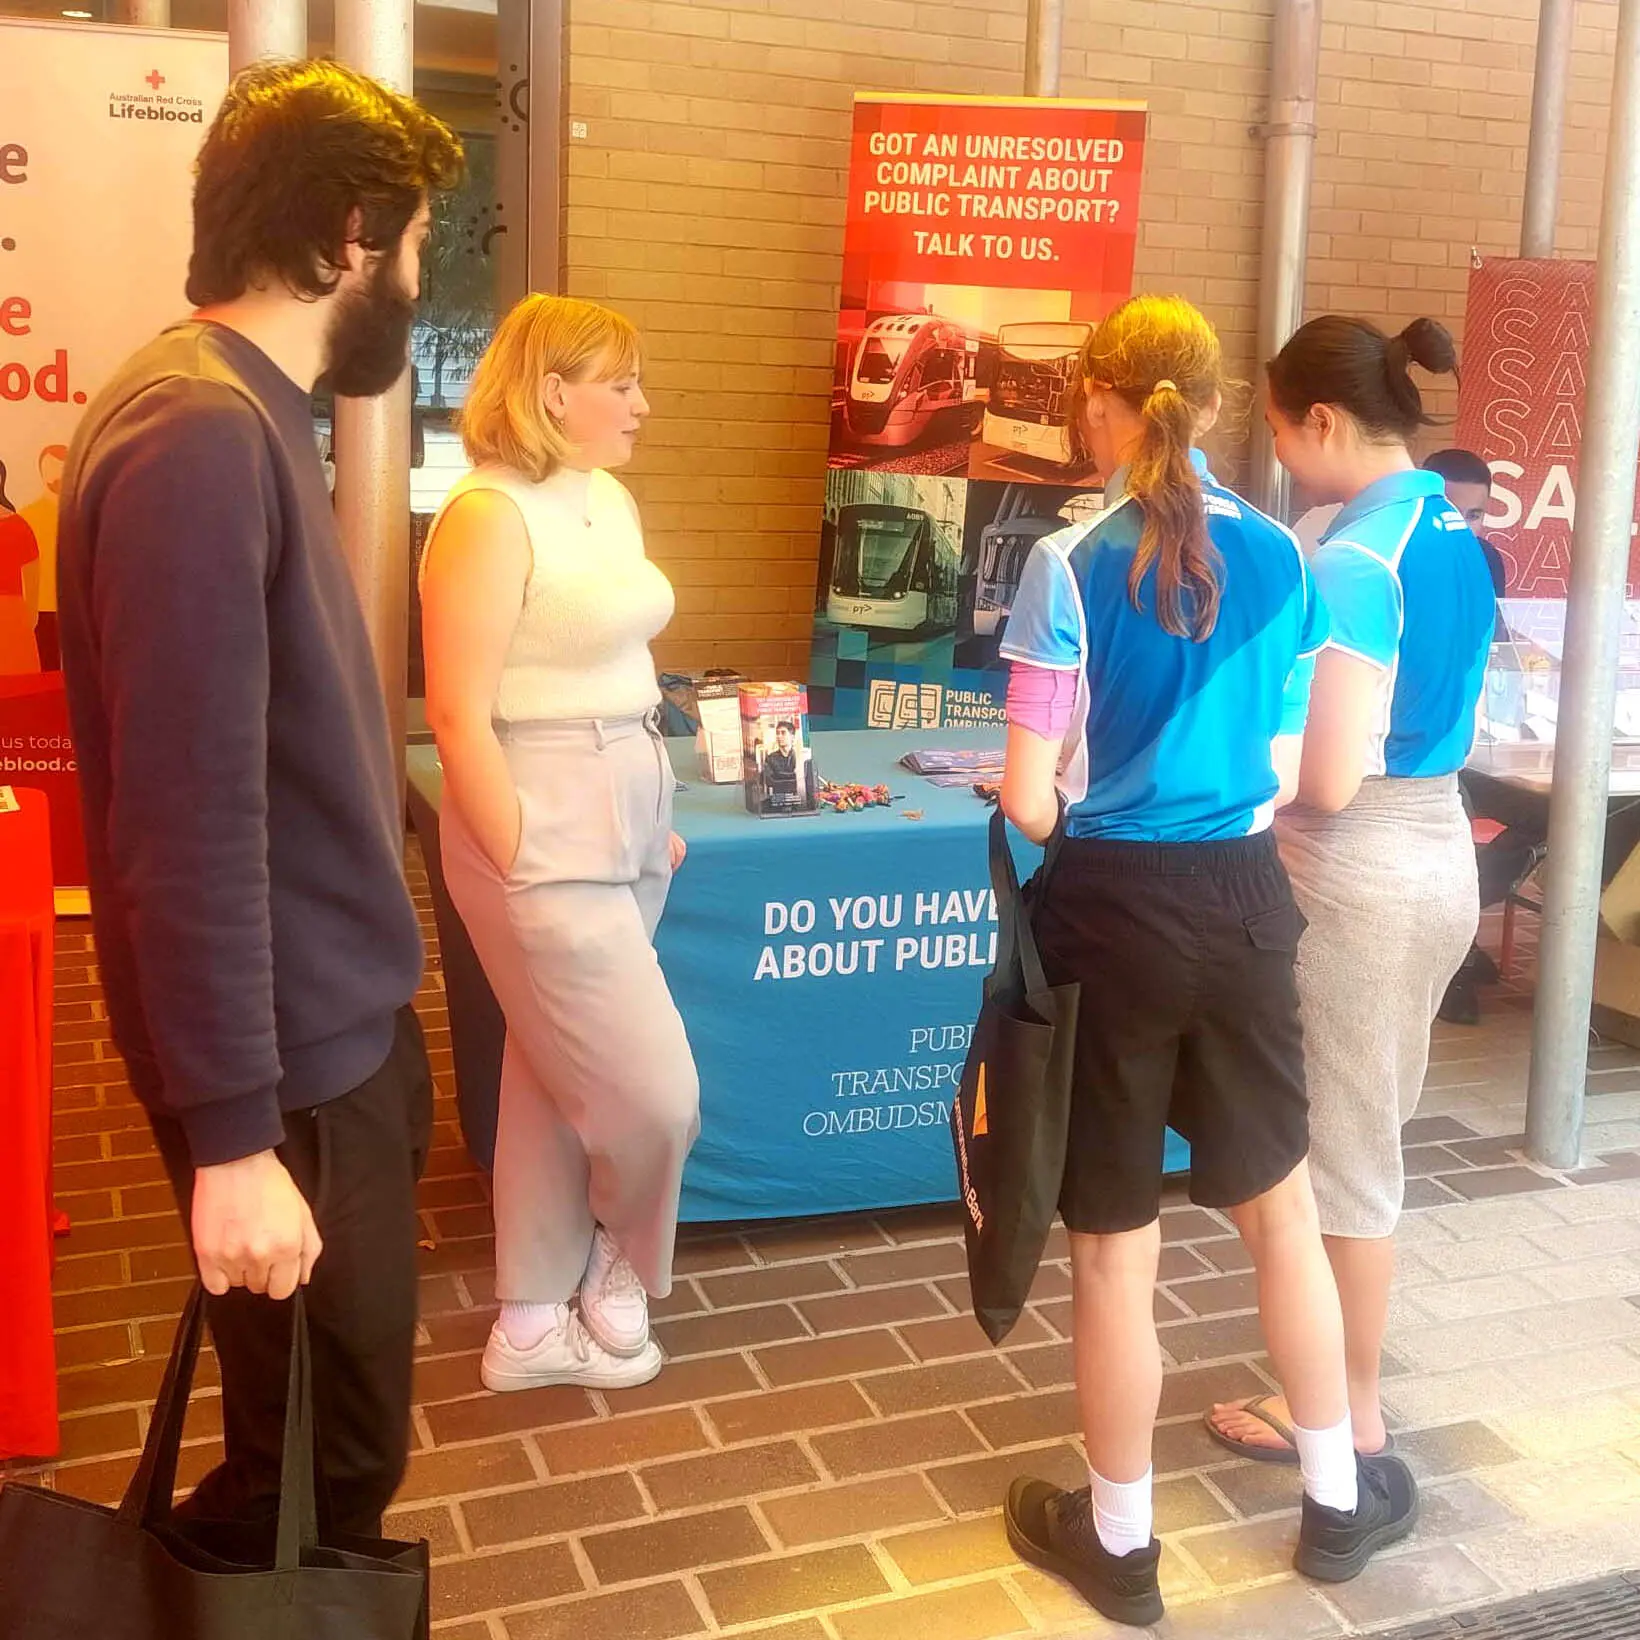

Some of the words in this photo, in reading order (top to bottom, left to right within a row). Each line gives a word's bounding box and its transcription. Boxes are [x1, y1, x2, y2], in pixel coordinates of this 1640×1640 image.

[109, 103, 203, 123] Lifeblood
[110, 92, 154, 104] Australian
[156, 95, 174, 105] Red
[176, 97, 202, 106] Cross
[869, 132, 917, 156] GOT
[922, 134, 958, 157] AN
[965, 135, 1124, 163] UNRESOLVED
[877, 162, 1021, 189] COMPLAINT
[1026, 168, 1113, 192] ABOUT
[864, 191, 950, 216] PUBLIC
[958, 194, 1120, 223] TRANSPORT?
[913, 231, 975, 257] TALK
[981, 235, 1013, 260] TO
[1021, 238, 1060, 261] US.
[1483, 460, 1577, 532] SA
[945, 689, 992, 706] PUBLIC
[945, 704, 1007, 721] TRANSPO
[2, 737, 23, 749] us
[29, 734, 73, 753] toda
[0, 756, 78, 772] blood.c
[764, 900, 816, 935] DO
[829, 894, 903, 932] YOU
[753, 938, 884, 981] ABOUT
